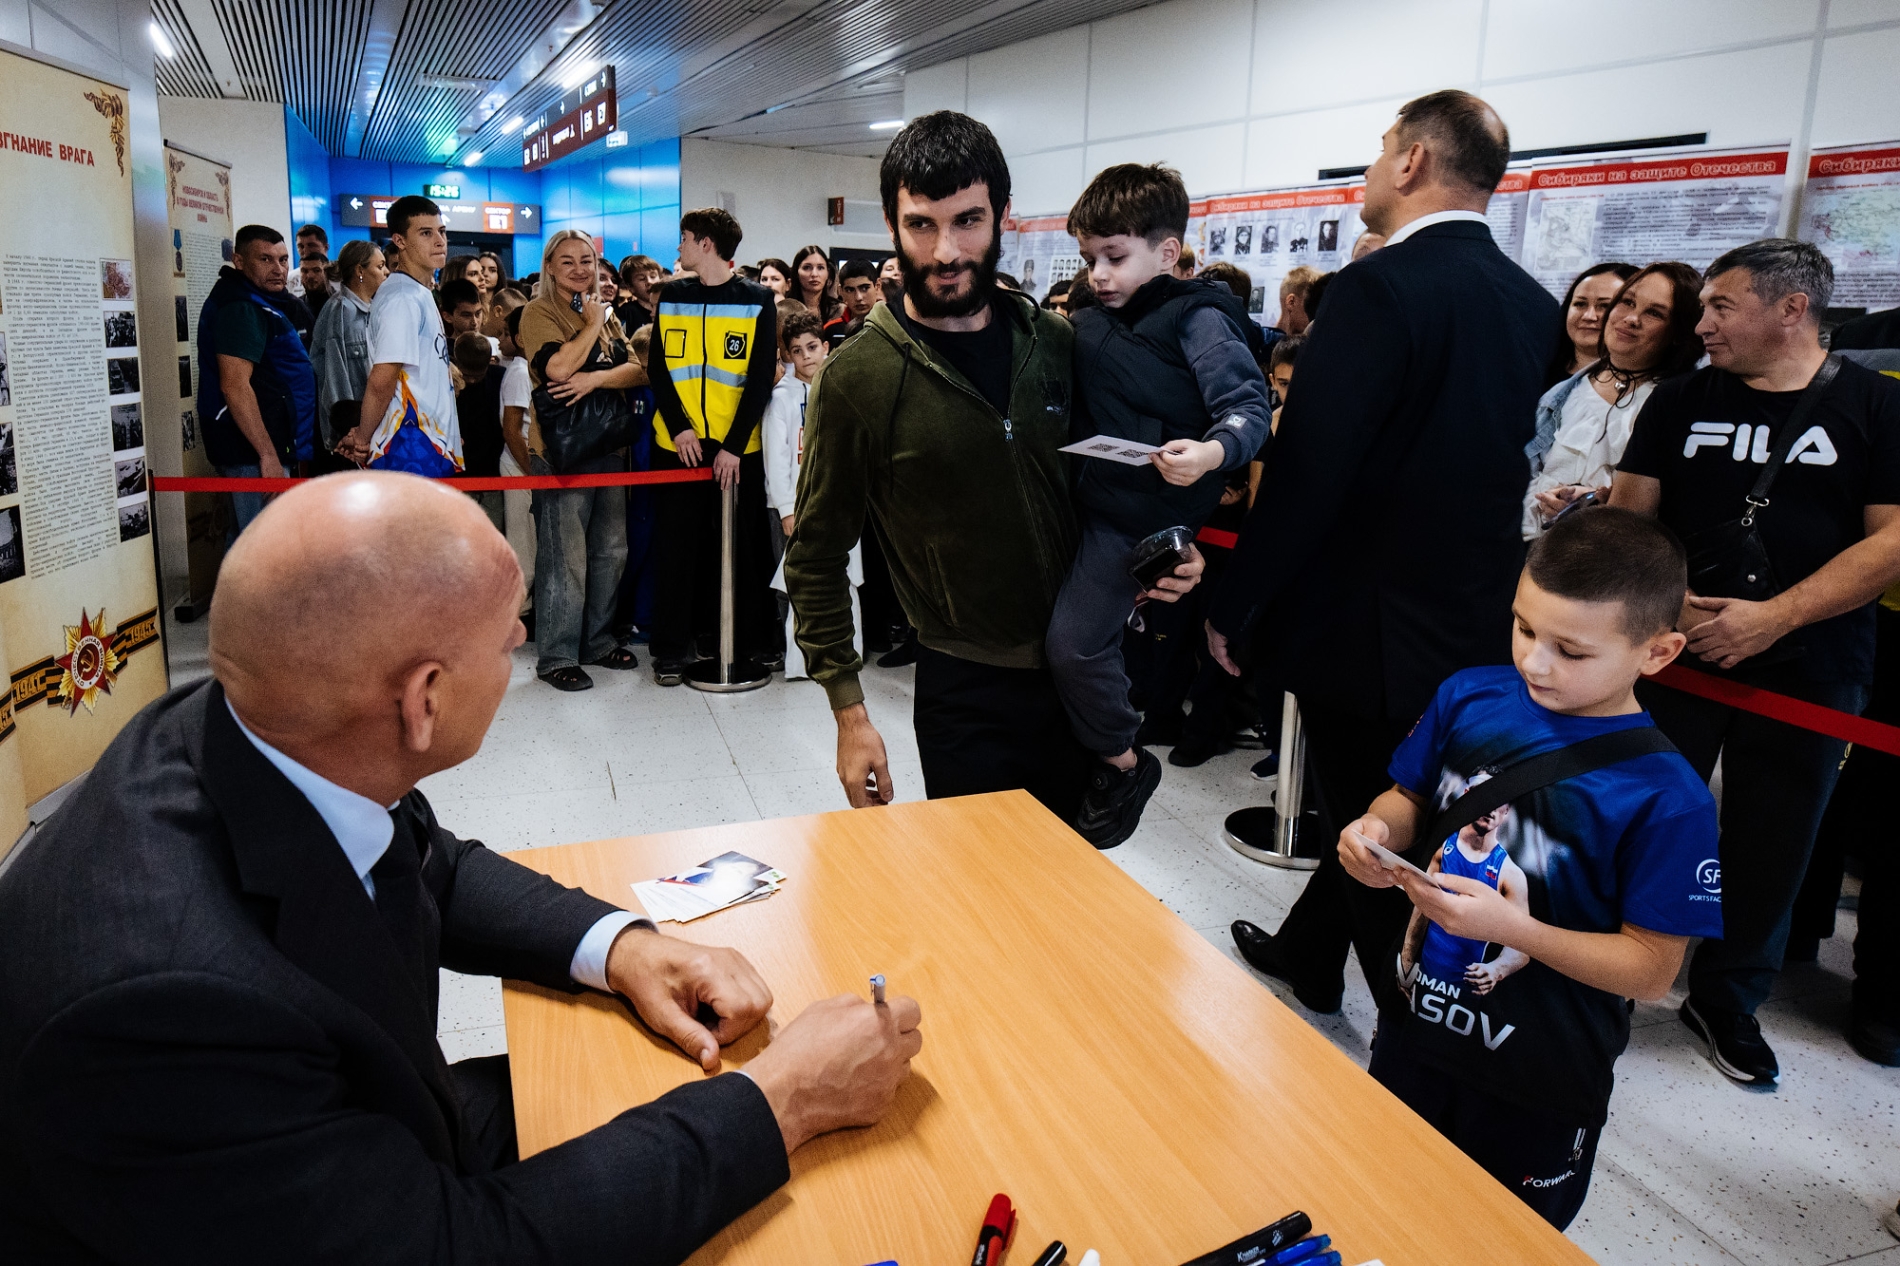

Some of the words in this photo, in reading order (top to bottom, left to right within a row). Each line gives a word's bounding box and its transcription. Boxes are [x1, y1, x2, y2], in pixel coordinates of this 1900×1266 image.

[59, 143, 95, 167] ВРАГА
[1538, 171, 1605, 187] Сибиряки
[1608, 170, 1627, 182] на
[1630, 166, 1687, 181] защите
[1690, 160, 1776, 177] Отечества
[729, 339, 740, 352] 26
[1683, 421, 1838, 466] FILA
[1703, 868, 1721, 884] SF
